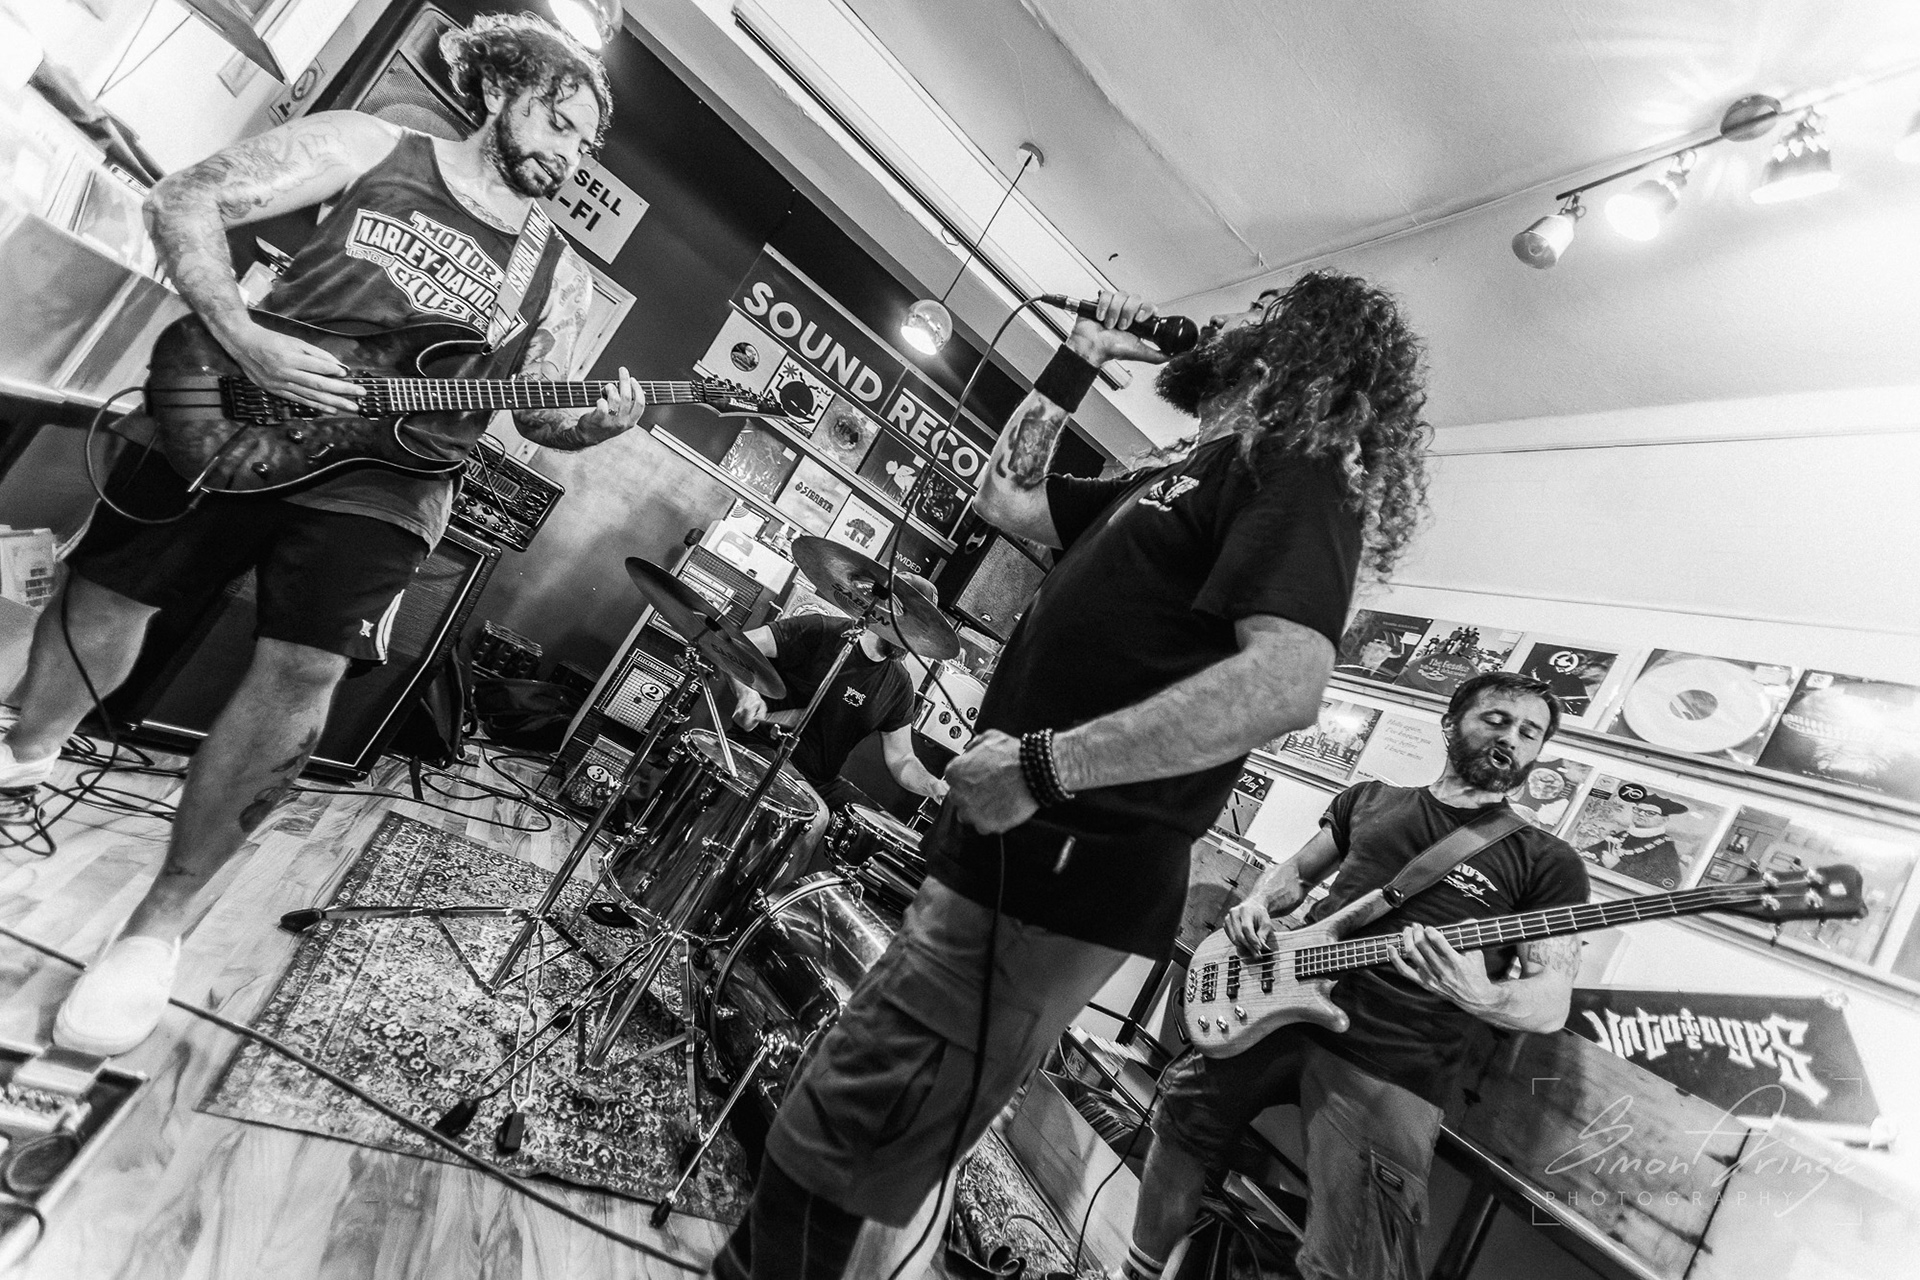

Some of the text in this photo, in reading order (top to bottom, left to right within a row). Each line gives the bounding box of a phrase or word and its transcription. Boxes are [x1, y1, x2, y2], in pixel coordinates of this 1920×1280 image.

[573, 168, 622, 217] SELL
[421, 220, 497, 283] MOTOR
[394, 267, 467, 315] CYCLES
[743, 281, 883, 402] SOUND
[645, 685, 660, 700] 2
[591, 767, 605, 780] 3
